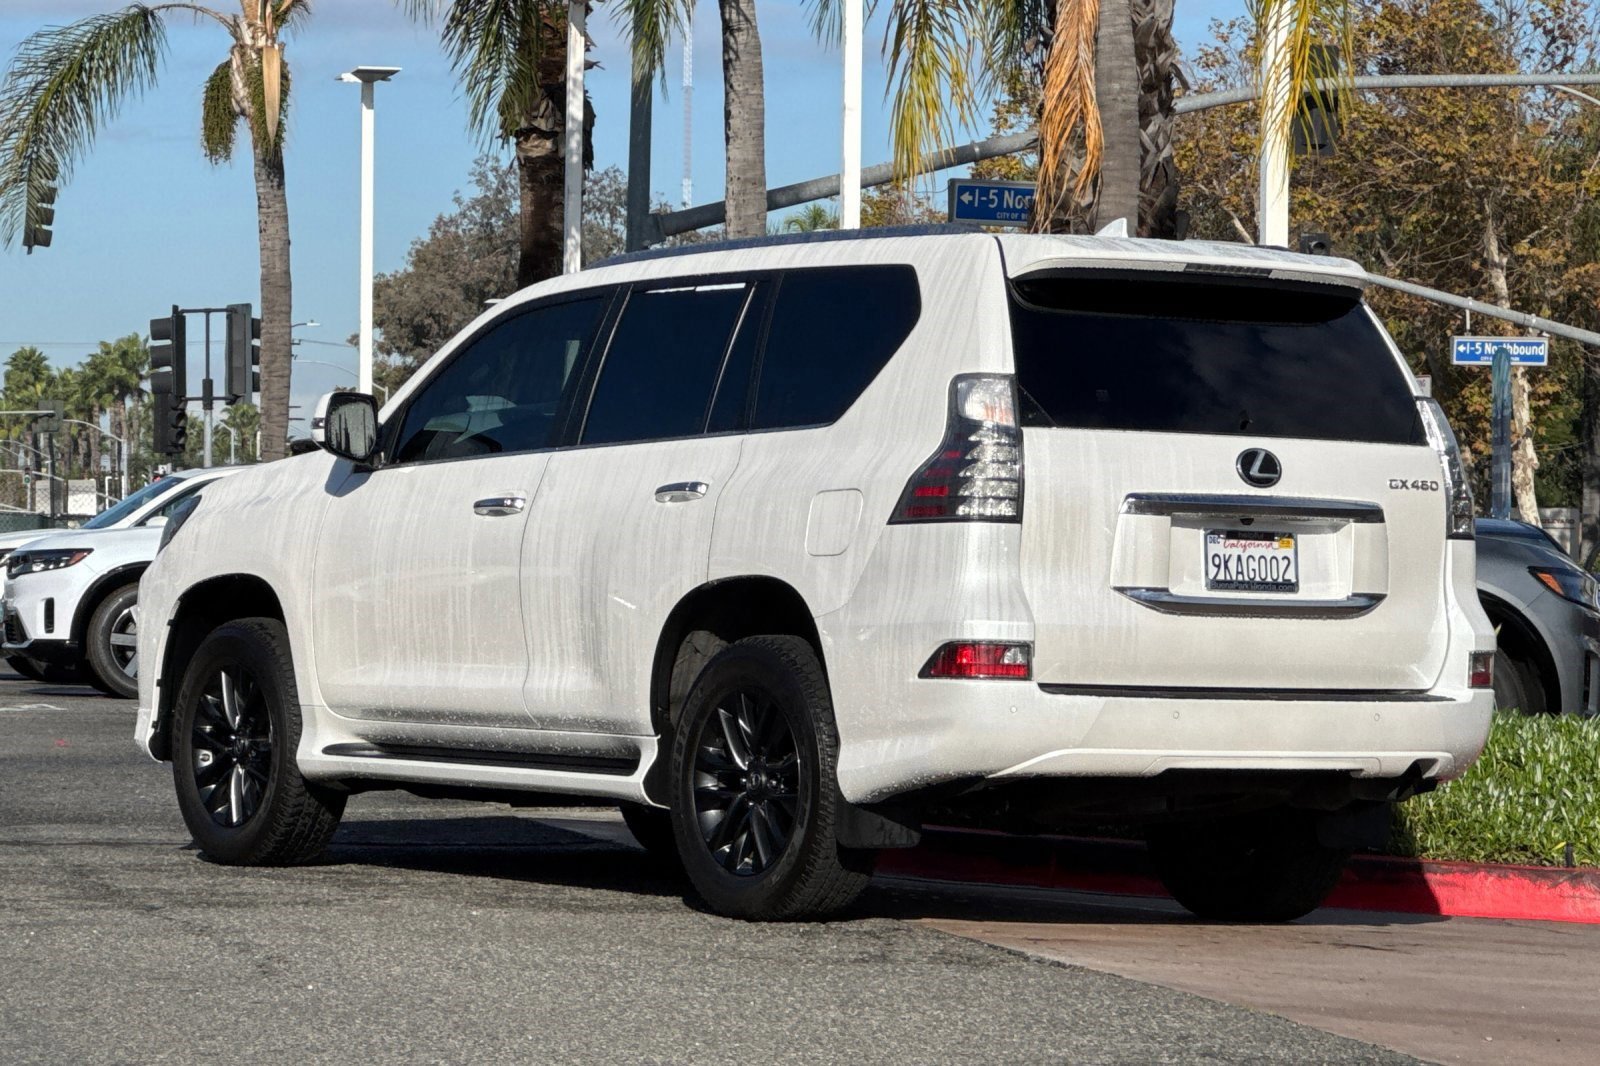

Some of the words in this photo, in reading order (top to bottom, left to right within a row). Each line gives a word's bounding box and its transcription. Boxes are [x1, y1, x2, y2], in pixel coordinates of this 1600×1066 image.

[974, 188, 998, 208] I-5
[996, 212, 1010, 220] CITY
[1011, 212, 1019, 220] OF
[1466, 342, 1482, 354] I-5
[1208, 536, 1220, 544] DEC
[1223, 540, 1274, 553] California
[1211, 553, 1291, 582] 9KAG002
